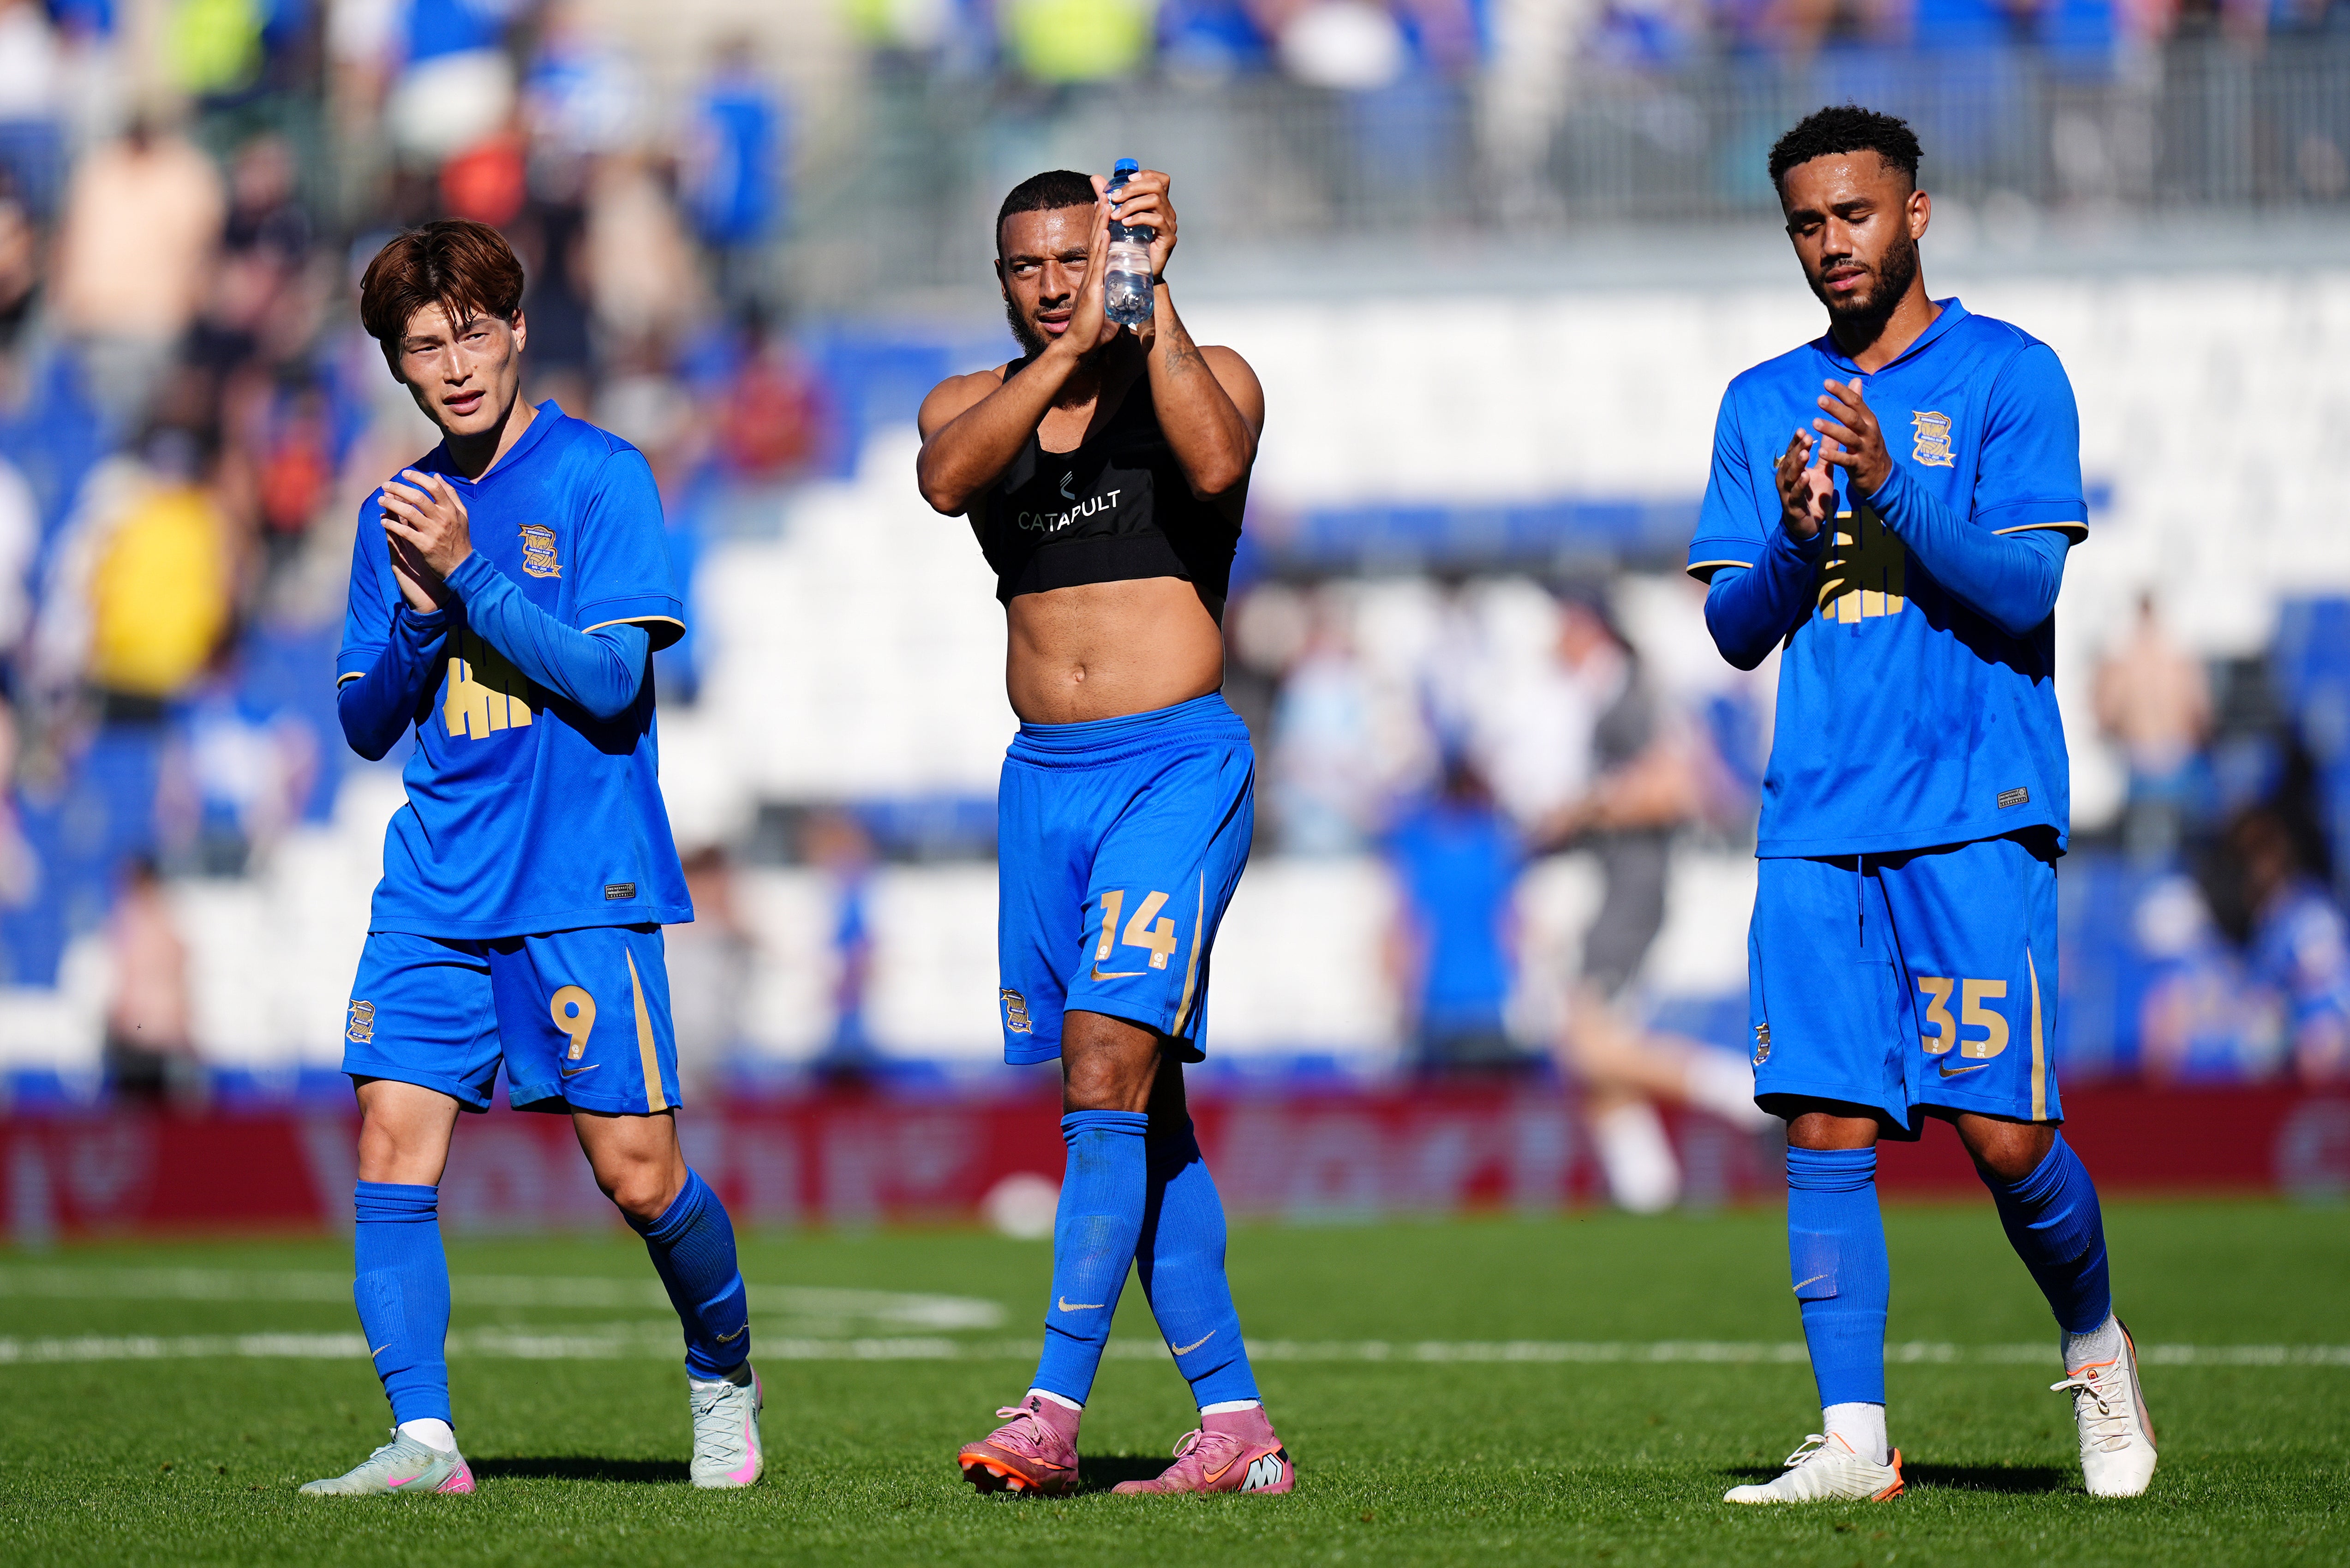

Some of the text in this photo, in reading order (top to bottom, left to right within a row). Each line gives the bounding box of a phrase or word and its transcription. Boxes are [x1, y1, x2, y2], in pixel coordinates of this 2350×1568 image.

[1018, 489, 1121, 532] CATAPULT
[1094, 889, 1177, 970] 14
[550, 984, 596, 1060] 9
[1917, 976, 2009, 1059] 35
